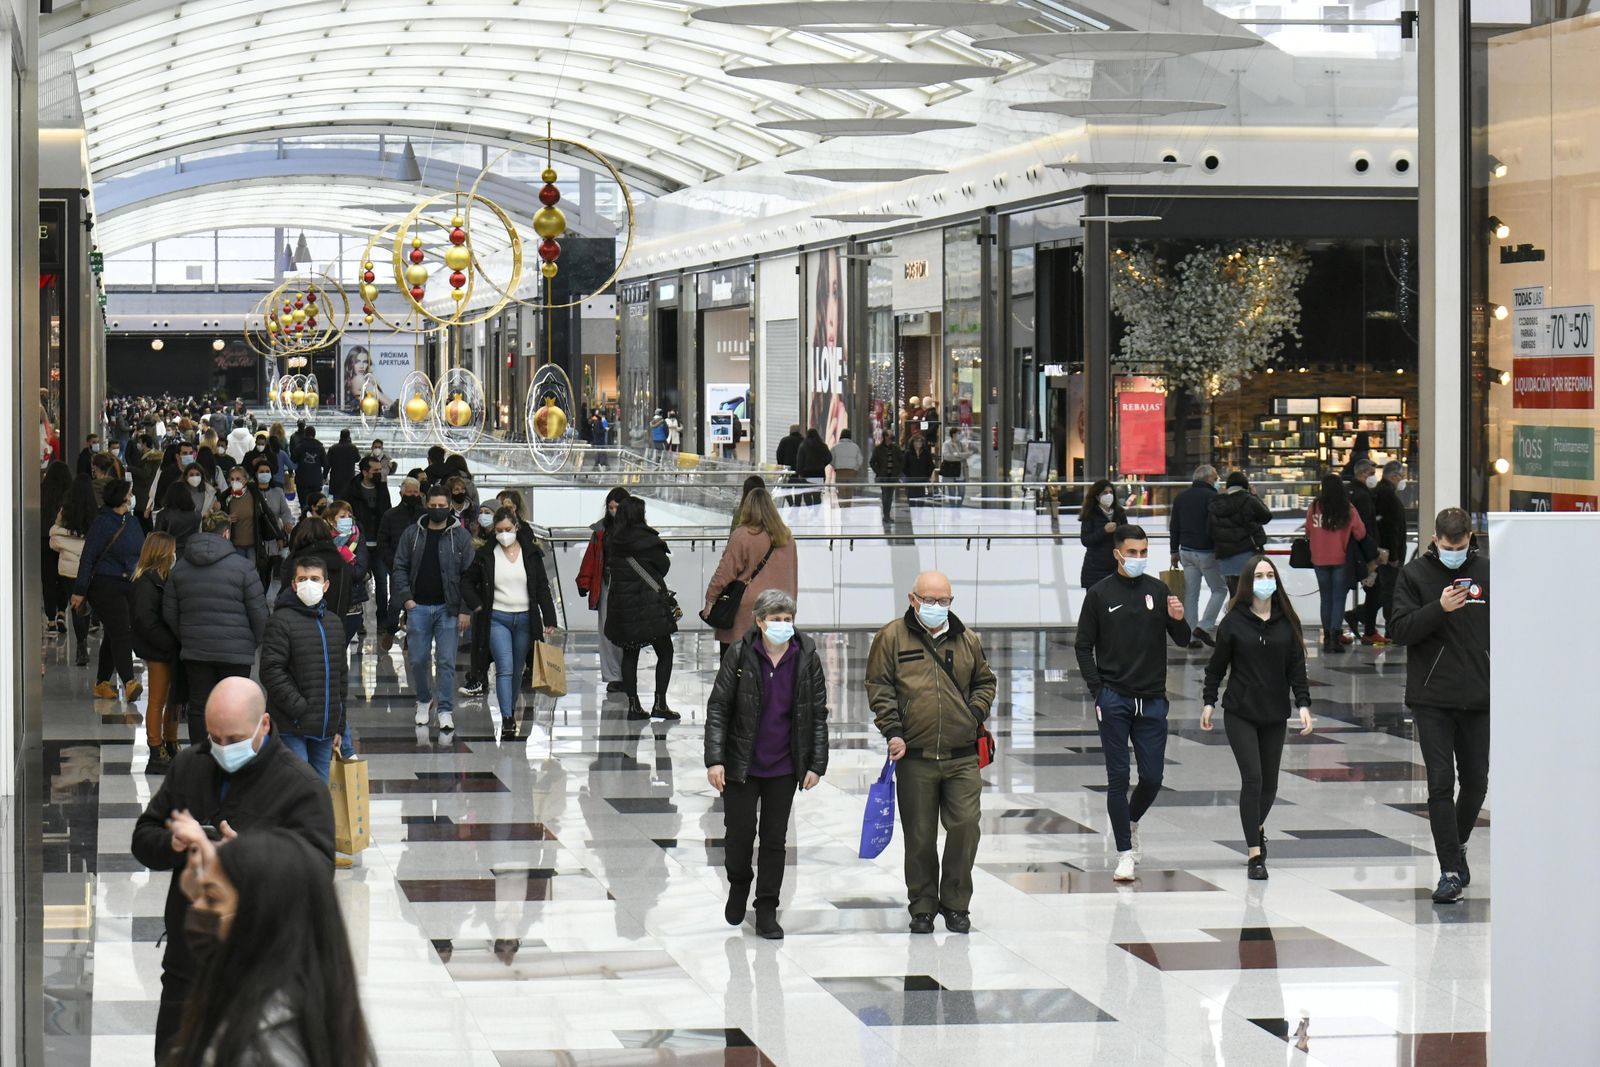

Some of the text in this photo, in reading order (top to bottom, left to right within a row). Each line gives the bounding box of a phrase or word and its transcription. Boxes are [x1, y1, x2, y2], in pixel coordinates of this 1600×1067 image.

[1514, 292, 1542, 307] TODAS LAS
[380, 350, 409, 359] PRÓXIMA
[815, 346, 843, 394] LOVE
[1514, 373, 1593, 396] LIQUIDACIÓN POR REFORMA
[1122, 403, 1162, 412] REBAJAS
[1518, 431, 1543, 459] hoss
